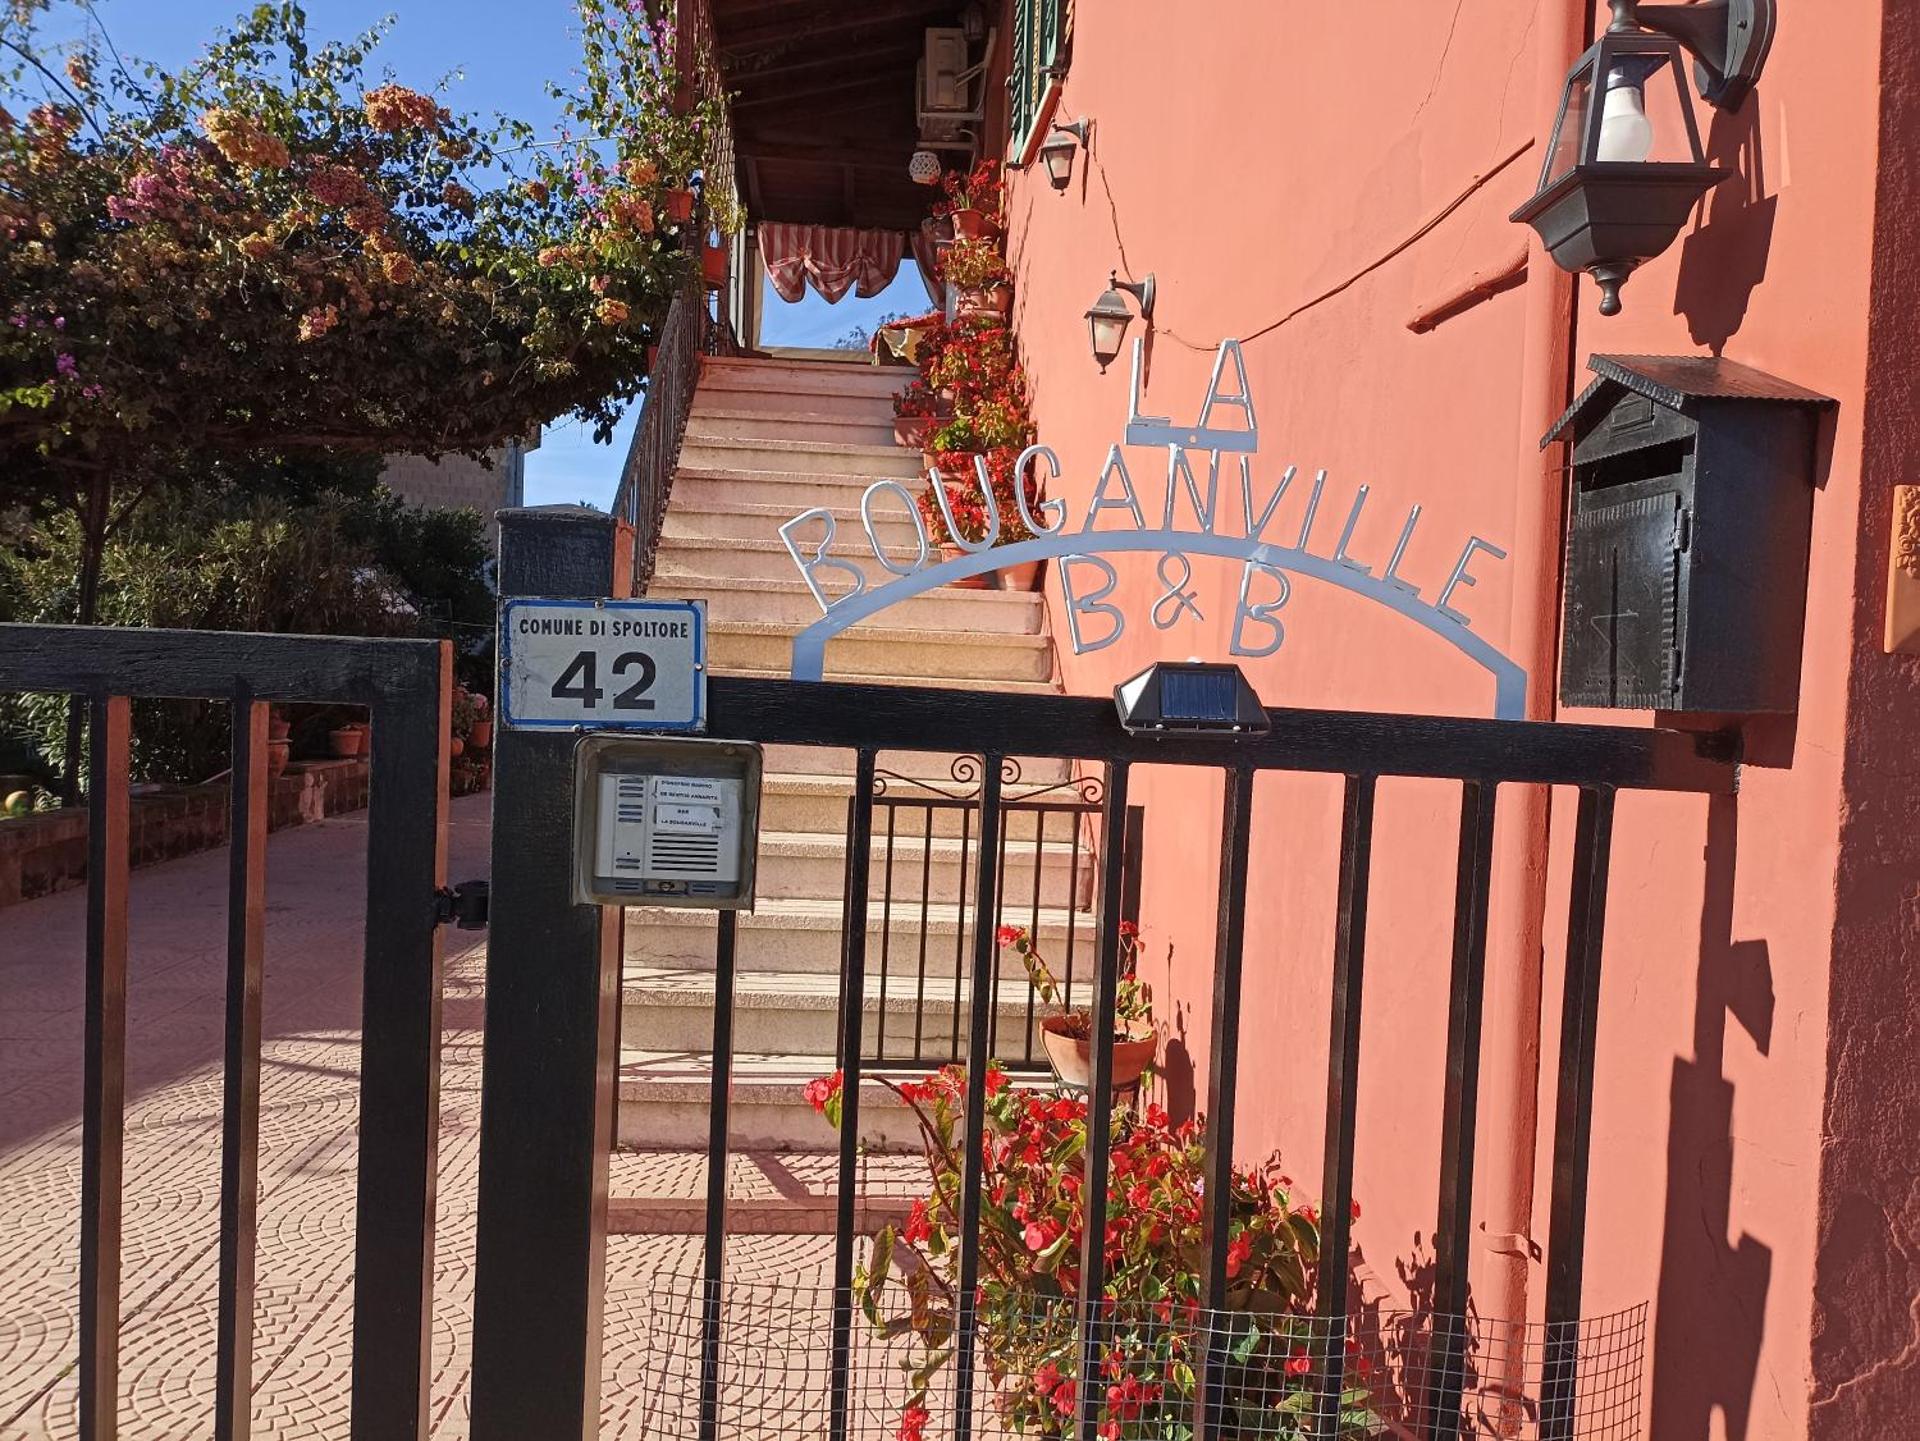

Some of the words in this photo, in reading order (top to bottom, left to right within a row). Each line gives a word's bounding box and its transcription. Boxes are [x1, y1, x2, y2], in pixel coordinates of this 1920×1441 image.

[1127, 338, 1257, 431] LA
[778, 442, 1507, 626] BOUGANVILLE
[519, 618, 583, 636] COMUNE
[589, 619, 606, 636] DI
[612, 620, 689, 639] SPOLTORE
[551, 650, 656, 710] 42
